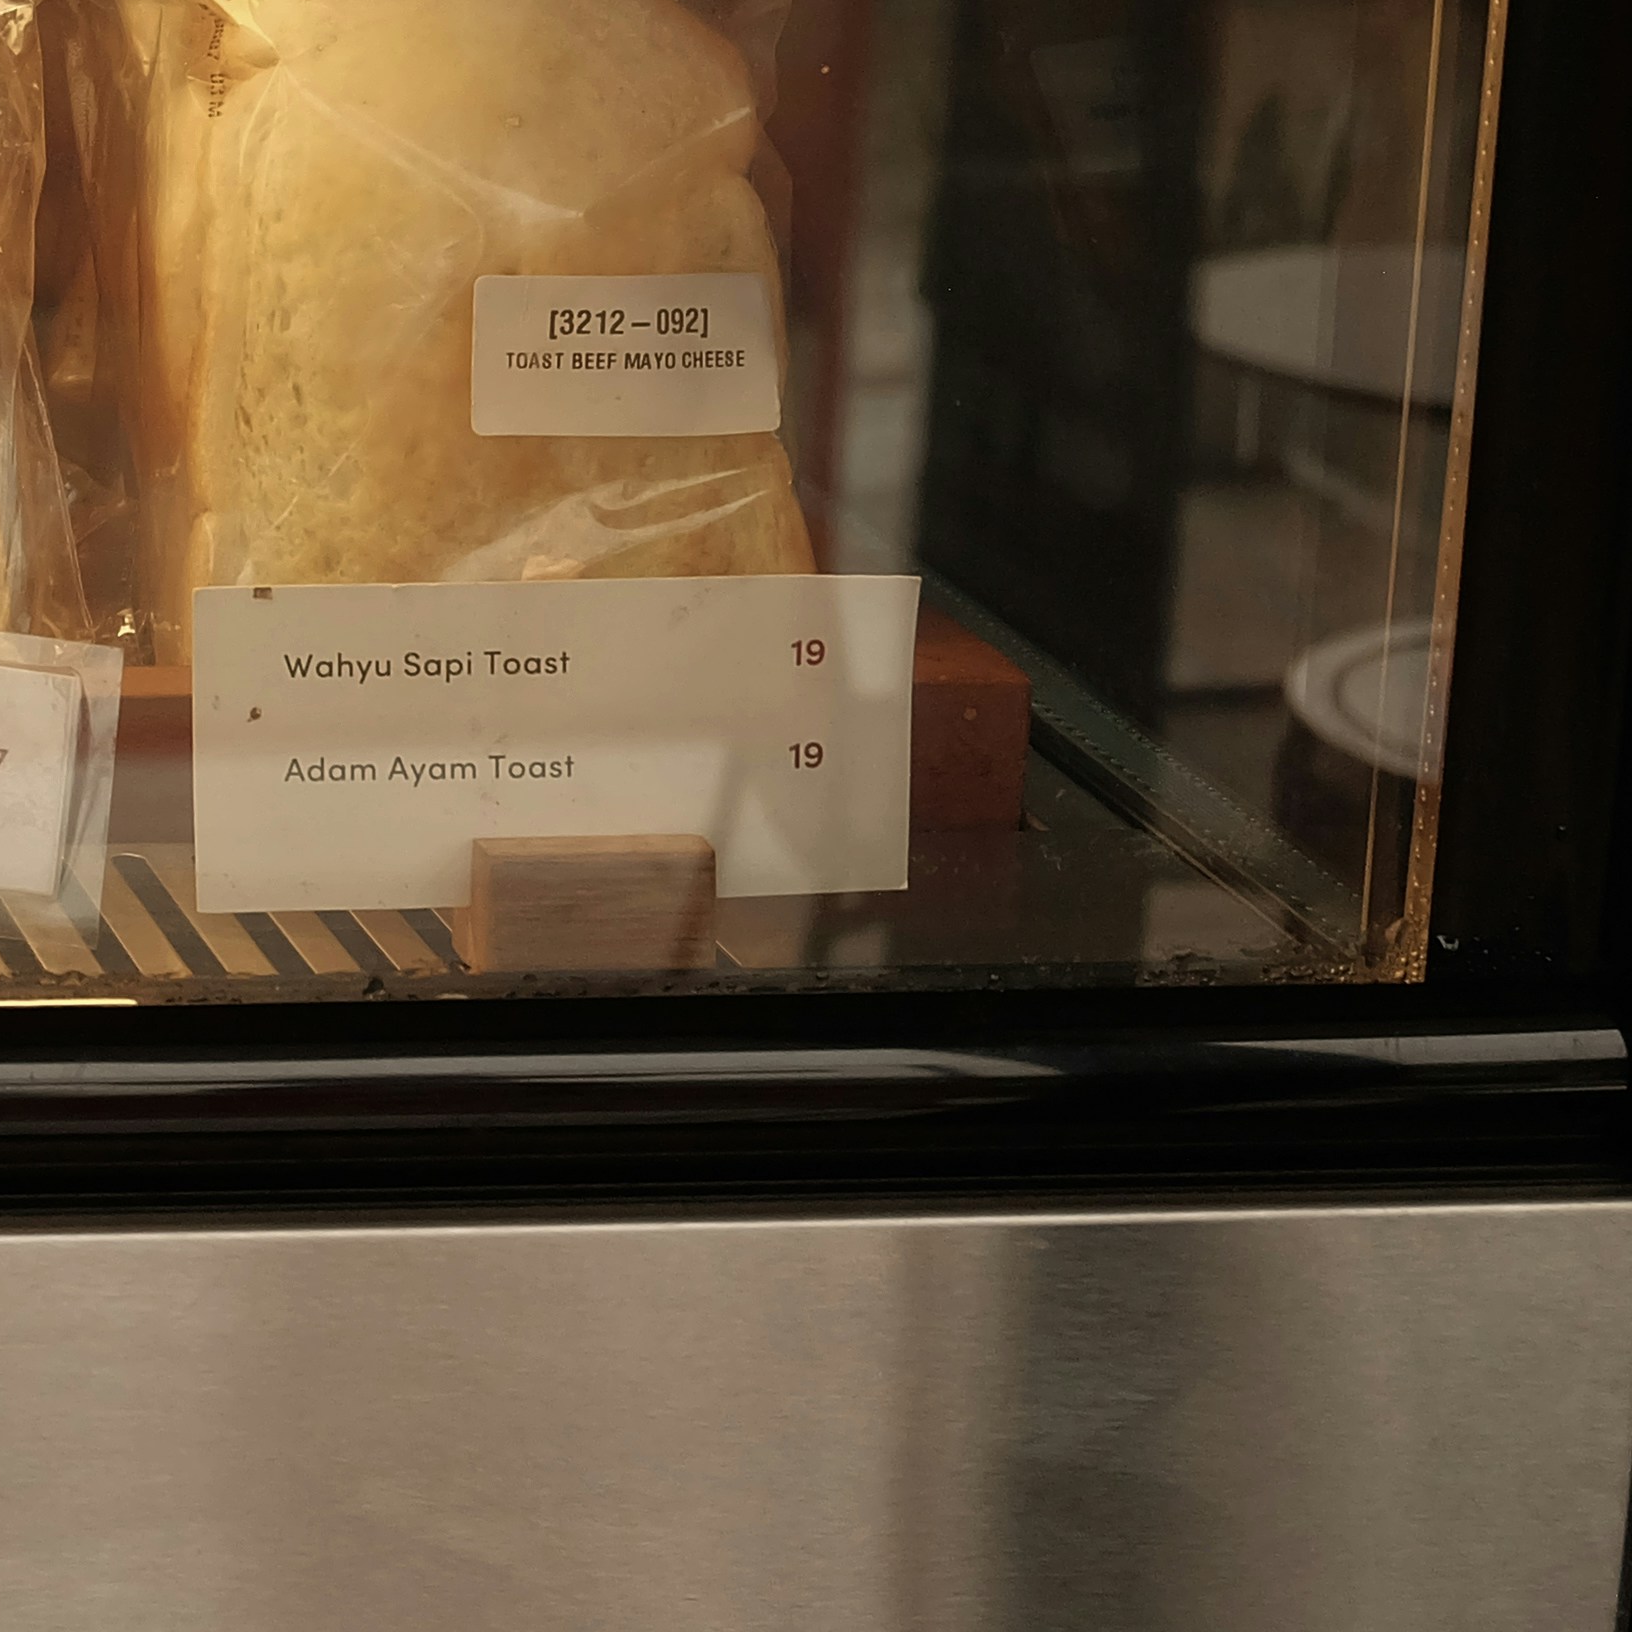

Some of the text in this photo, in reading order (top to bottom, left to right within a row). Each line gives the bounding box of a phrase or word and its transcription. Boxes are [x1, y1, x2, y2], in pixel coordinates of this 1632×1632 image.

[506, 349, 745, 370] TOAST BEEF MAYO CHEESE
[283, 639, 826, 685] Wahyu Sapi Toast 19
[284, 741, 824, 788] Adam Ayam Toast 19
